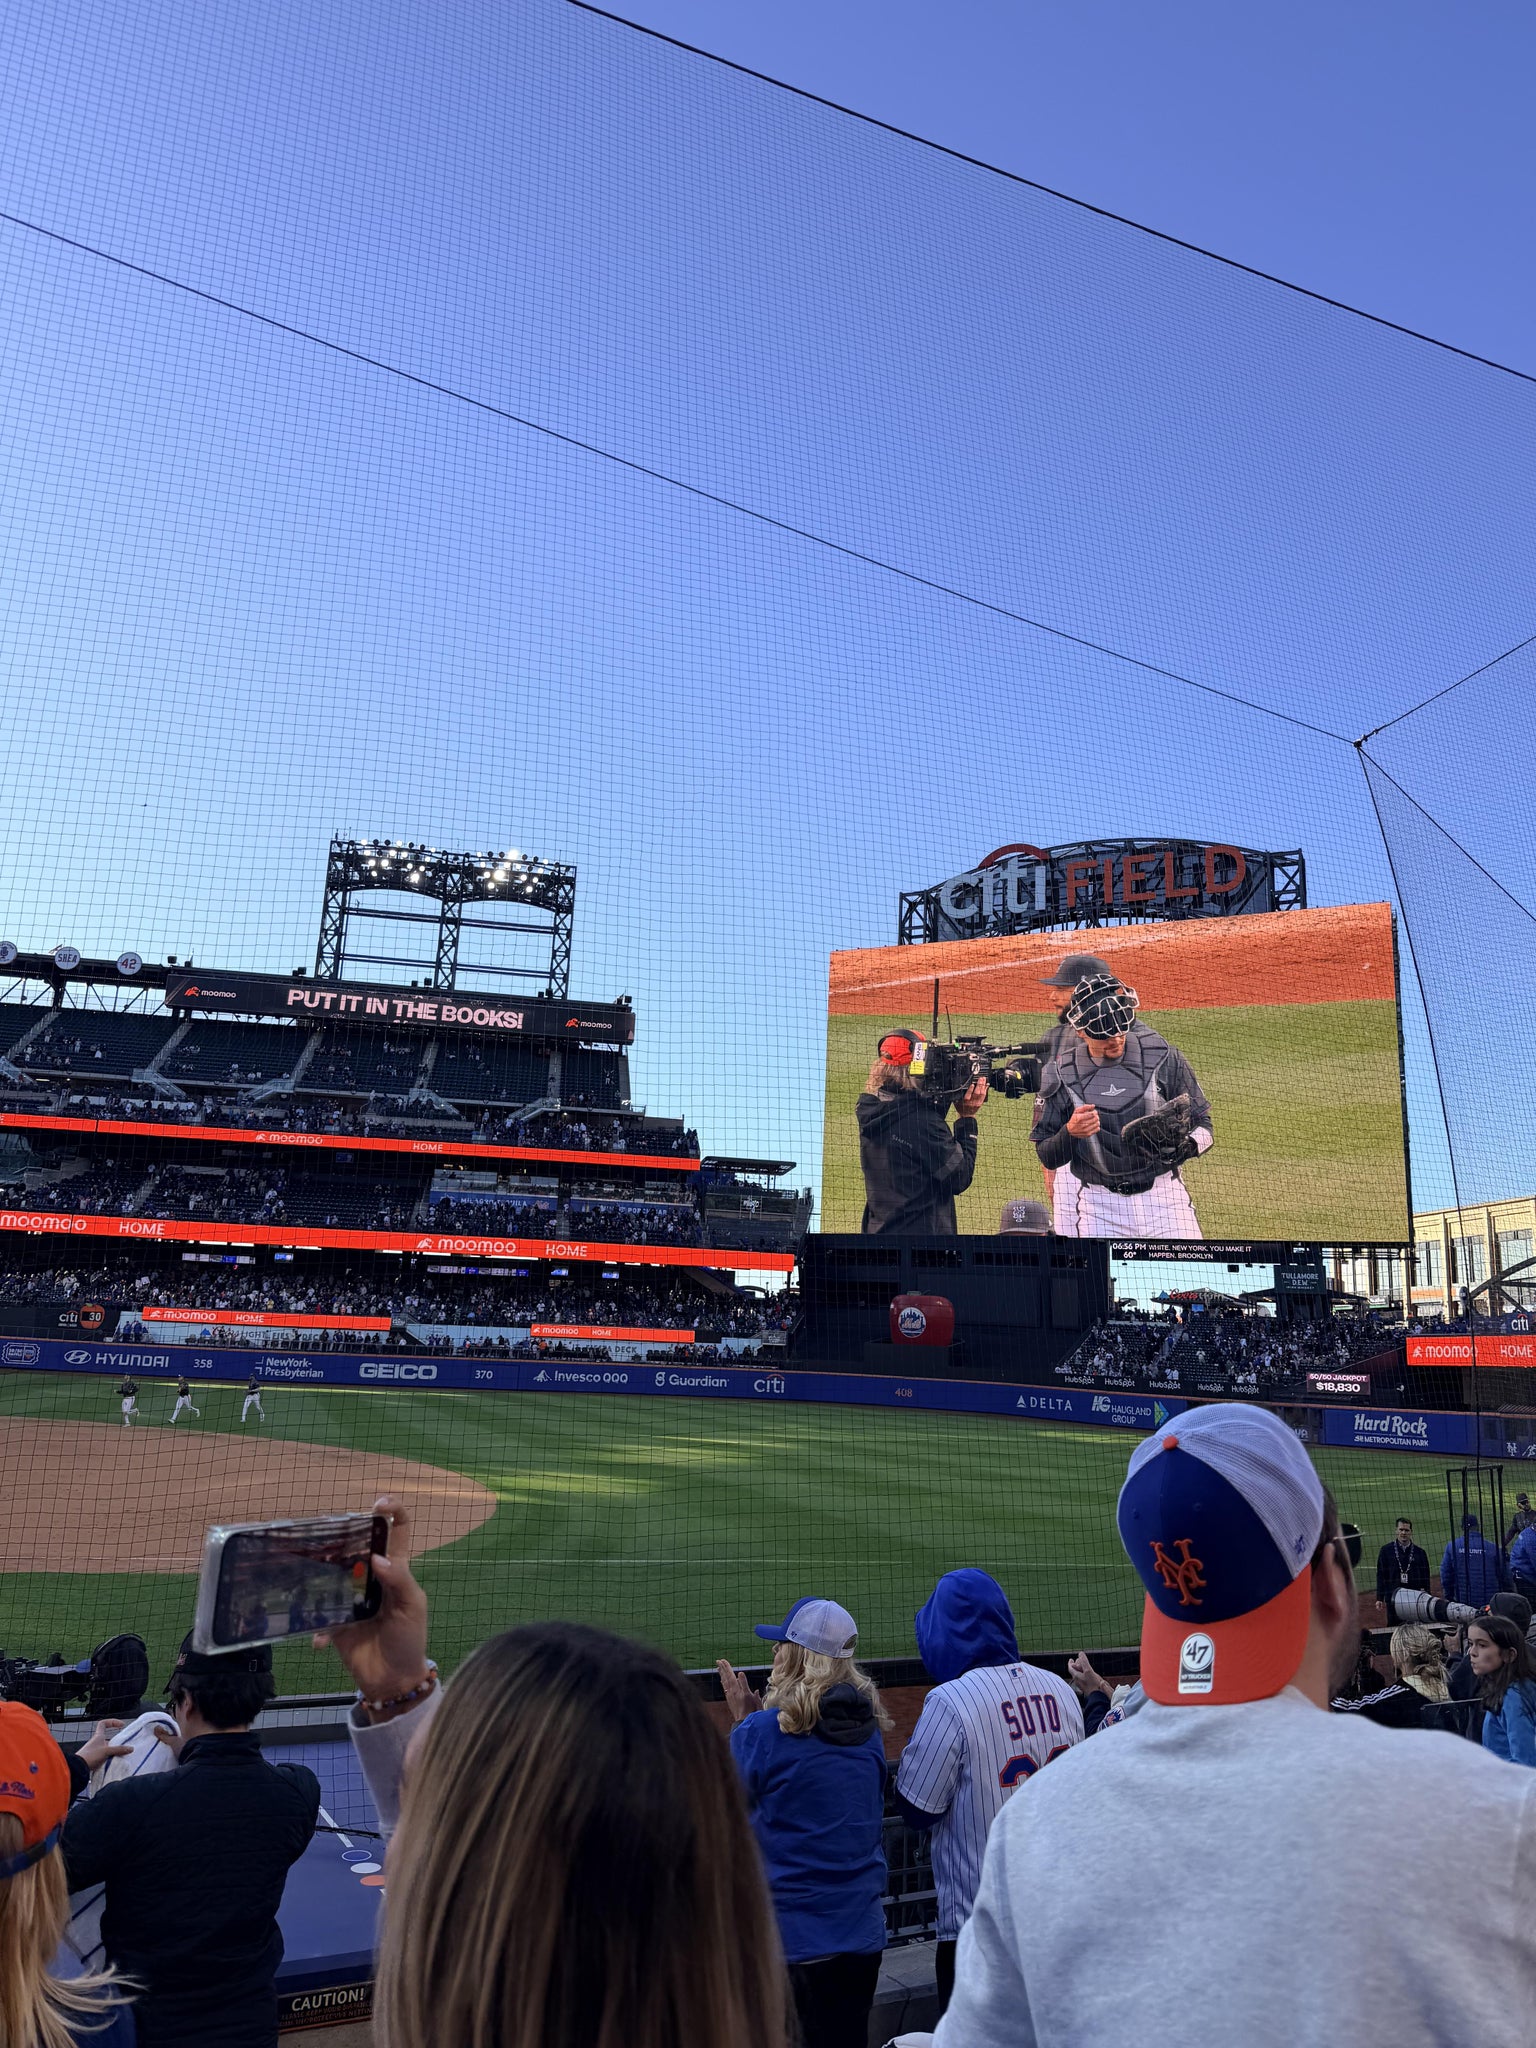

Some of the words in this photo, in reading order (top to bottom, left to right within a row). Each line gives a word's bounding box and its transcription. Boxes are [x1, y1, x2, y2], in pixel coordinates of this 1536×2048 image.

[940, 844, 1050, 918] citi
[1066, 845, 1246, 907] FIELD
[58, 953, 77, 964] SHEA
[121, 958, 137, 970] 42
[201, 990, 236, 998] moomoo
[287, 989, 337, 1009] PUT
[339, 995, 363, 1012] IT
[365, 997, 388, 1015] IN
[392, 999, 437, 1020] THE
[441, 1006, 524, 1030] BOOKS!
[580, 1021, 612, 1029] moomoo
[269, 1134, 323, 1145] moomoo
[413, 1142, 443, 1152] HOME
[0, 1213, 87, 1231] moomoo
[119, 1222, 166, 1235] HOME
[438, 1239, 516, 1254] moomoo
[546, 1243, 588, 1257] HOME
[1112, 1242, 1133, 1250] 06:56
[1135, 1242, 1147, 1250] PM
[1178, 1252, 1214, 1260] BROOKLYN
[1281, 1272, 1319, 1281] TULLAMORE
[1170, 1288, 1198, 1300] Coors
[59, 1310, 79, 1323] citi
[89, 1312, 101, 1321] 30
[163, 1310, 217, 1321] moomoo
[235, 1313, 265, 1323] HOME
[1511, 1313, 1530, 1331] citi
[542, 1327, 579, 1335] moomoo
[592, 1329, 612, 1337] HOME
[614, 1346, 637, 1354] DECK
[1425, 1345, 1478, 1358] moomoo
[1500, 1344, 1533, 1358] HOME
[95, 1353, 169, 1368] HYUNDAI
[193, 1359, 213, 1369] 358
[266, 1357, 312, 1368] NewYork-
[265, 1366, 324, 1379] Presbyterian
[359, 1362, 438, 1380] GEICO
[475, 1370, 493, 1380] 370
[554, 1370, 601, 1383] Invesco
[602, 1372, 628, 1383] QQQ
[669, 1373, 728, 1388] Guardian
[1065, 1375, 1095, 1385] HubSpot
[1105, 1378, 1135, 1388] HubSpot
[1310, 1373, 1332, 1381] 50/50
[1333, 1374, 1367, 1382] JACKPOT
[754, 1374, 785, 1394] citi
[1150, 1380, 1181, 1390] HubSpot
[1198, 1383, 1225, 1393] HubSpot
[1231, 1384, 1260, 1394] HubSpot
[1316, 1381, 1361, 1393] $18,830
[895, 1387, 913, 1398] 408
[1030, 1396, 1073, 1412] DELTA
[1111, 1404, 1152, 1417] HAUGLAND
[1111, 1414, 1137, 1425] GROUP
[1354, 1413, 1390, 1432] Hard
[1391, 1415, 1428, 1438] Rock
[1365, 1436, 1411, 1447] METROPOLITAN
[1412, 1439, 1429, 1447] PARK
[1001, 1694, 1061, 1741] SOTO
[291, 1987, 365, 2012] CAUTION!
